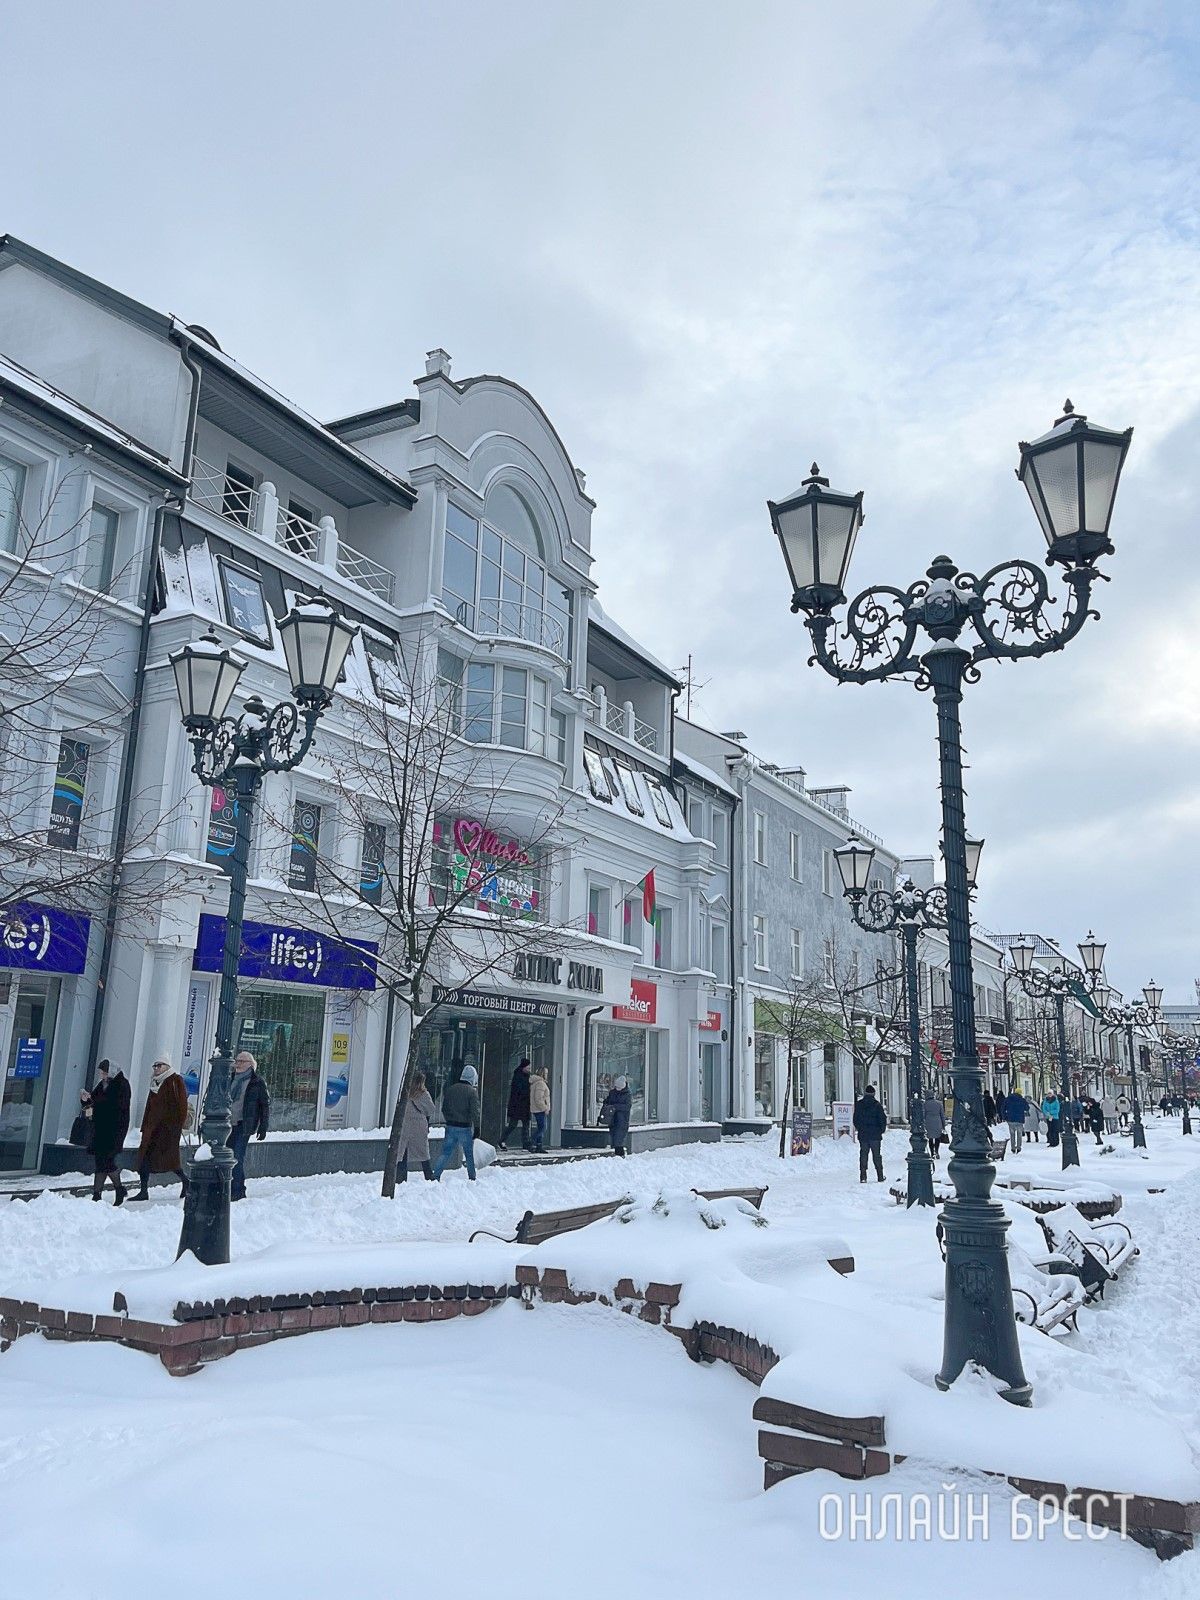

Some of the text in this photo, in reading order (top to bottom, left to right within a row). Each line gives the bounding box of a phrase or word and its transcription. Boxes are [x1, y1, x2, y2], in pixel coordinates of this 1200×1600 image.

[185, 987, 198, 1057] Бесконечный
[462, 994, 537, 1013] ТОРГОВЫЙ ЦЕНТР
